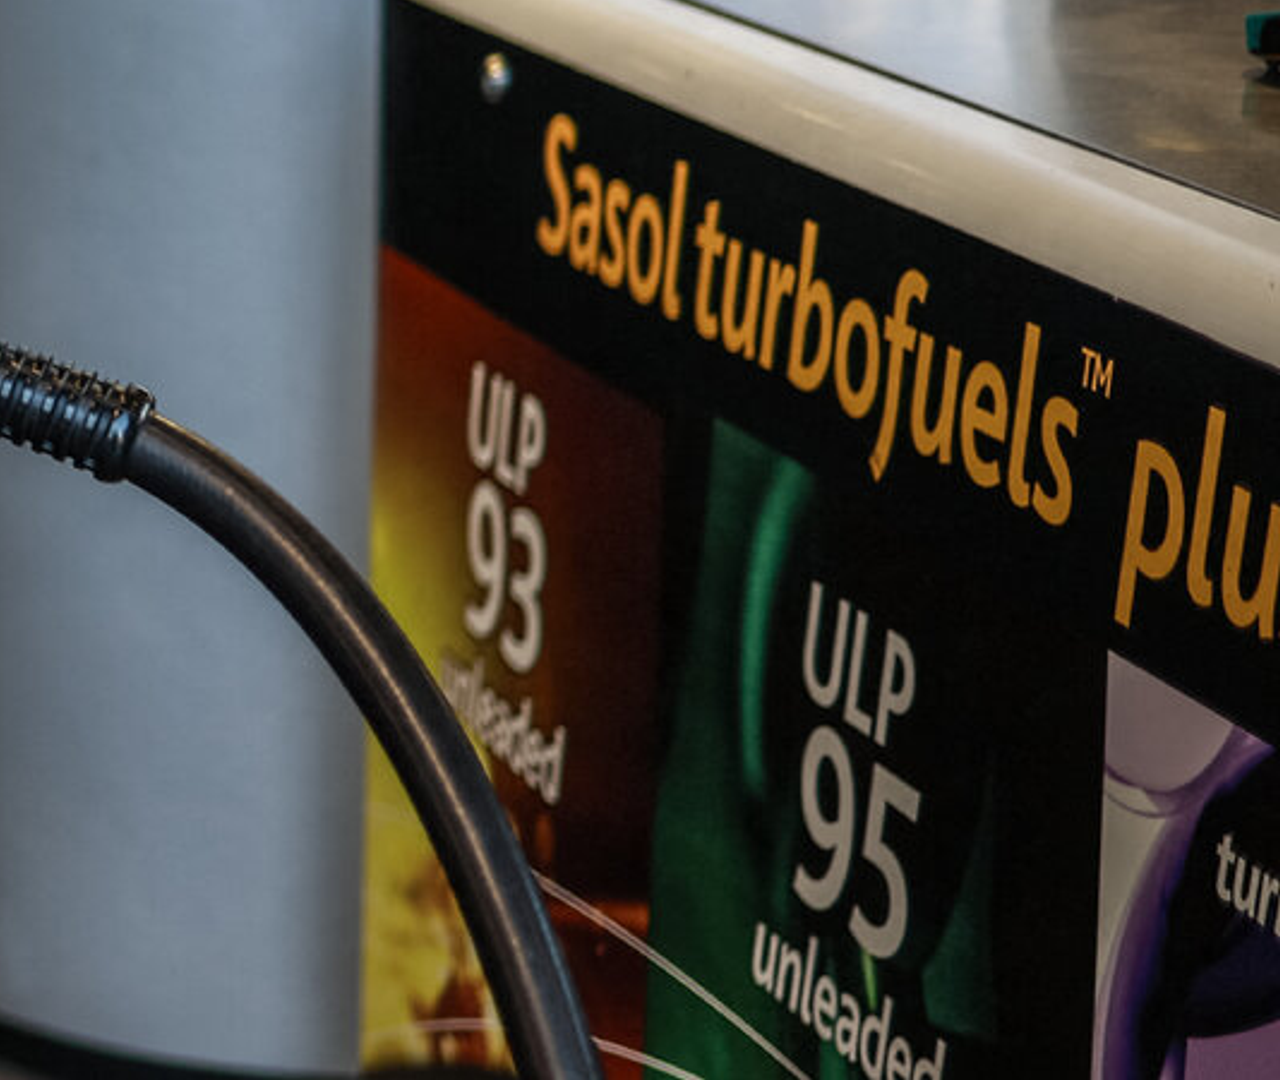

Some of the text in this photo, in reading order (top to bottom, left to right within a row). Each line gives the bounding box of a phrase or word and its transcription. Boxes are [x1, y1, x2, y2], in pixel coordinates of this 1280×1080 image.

[467, 360, 547, 496] ULP
[536, 113, 689, 321] Sasol
[1114, 405, 1280, 641] plu
[463, 478, 548, 673] 93
[802, 580, 915, 747] ULP
[792, 725, 921, 959] 95
[1216, 834, 1280, 937] tur
